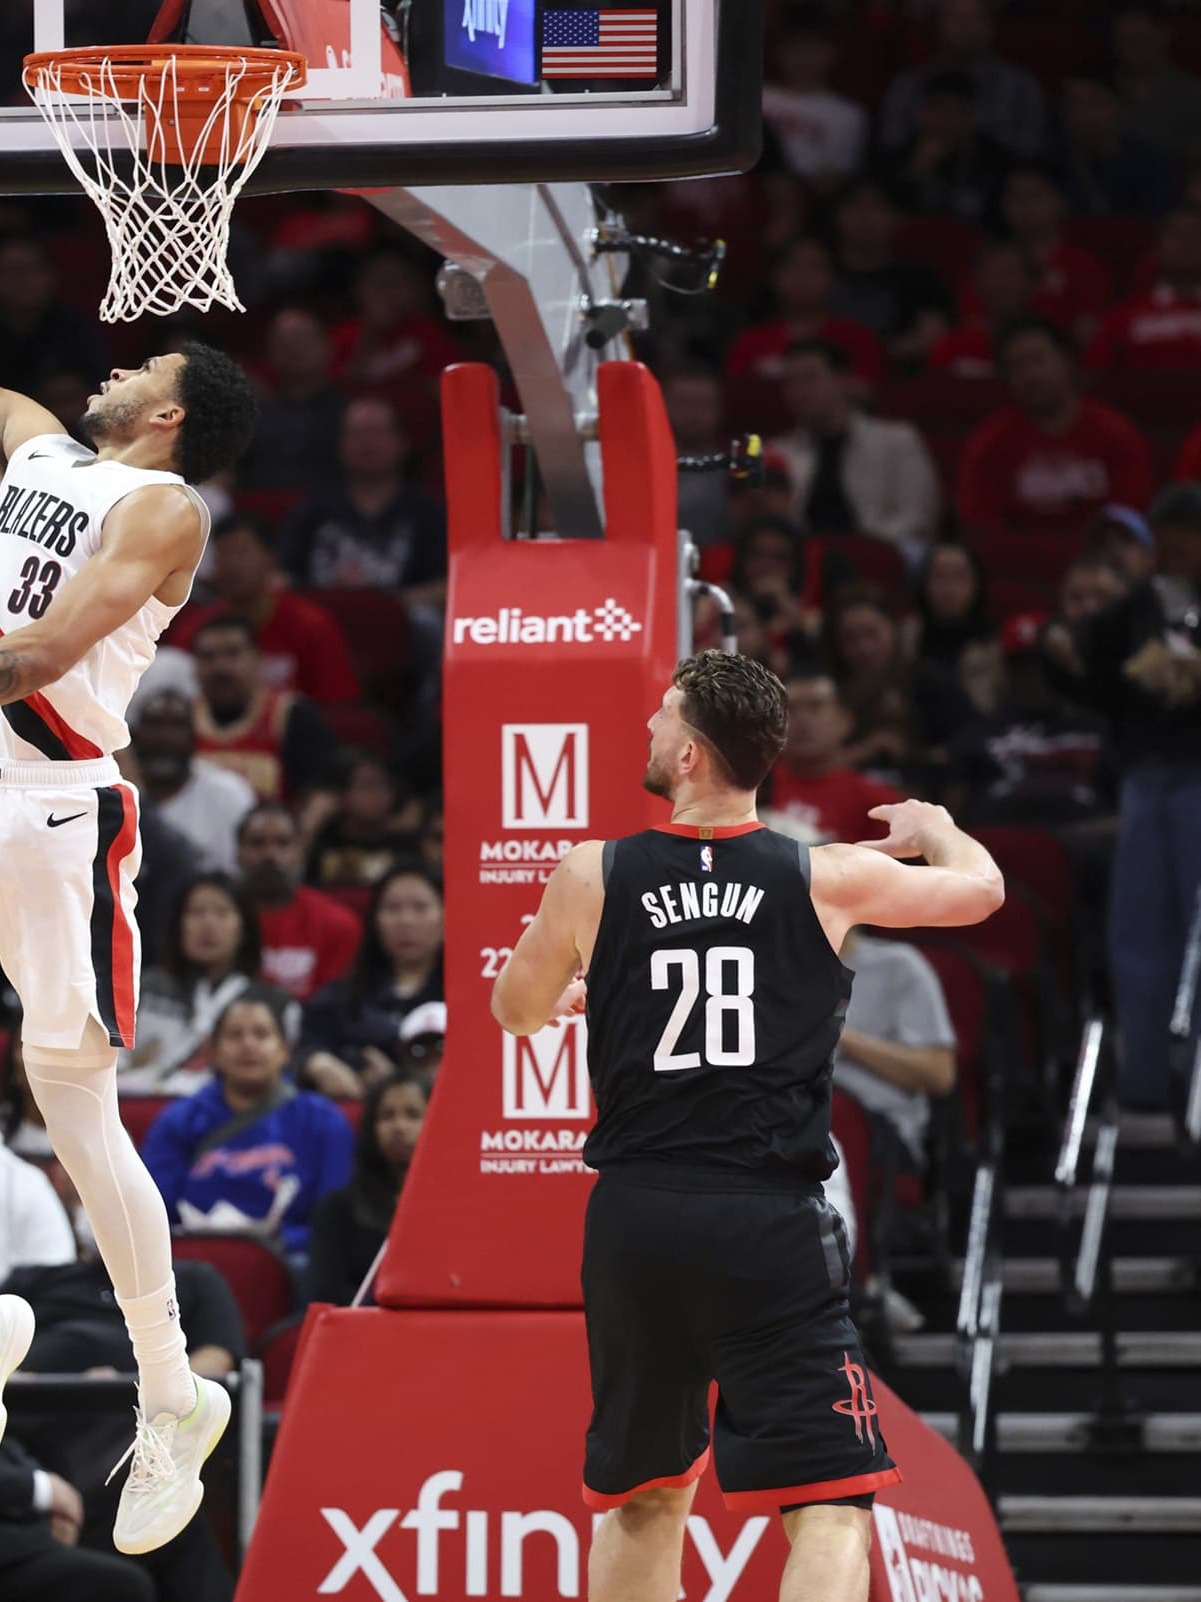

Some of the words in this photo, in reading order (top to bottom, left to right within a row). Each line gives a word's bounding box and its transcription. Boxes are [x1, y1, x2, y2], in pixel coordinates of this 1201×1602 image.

[7, 556, 62, 620] 33
[453, 608, 593, 644] reliant
[480, 840, 575, 861] MOKAR
[479, 869, 535, 884] INJURY
[641, 882, 765, 929] SENGUN
[651, 946, 756, 1072] 28
[480, 1159, 537, 1174] INJURY
[317, 1470, 770, 1602] xfiny
